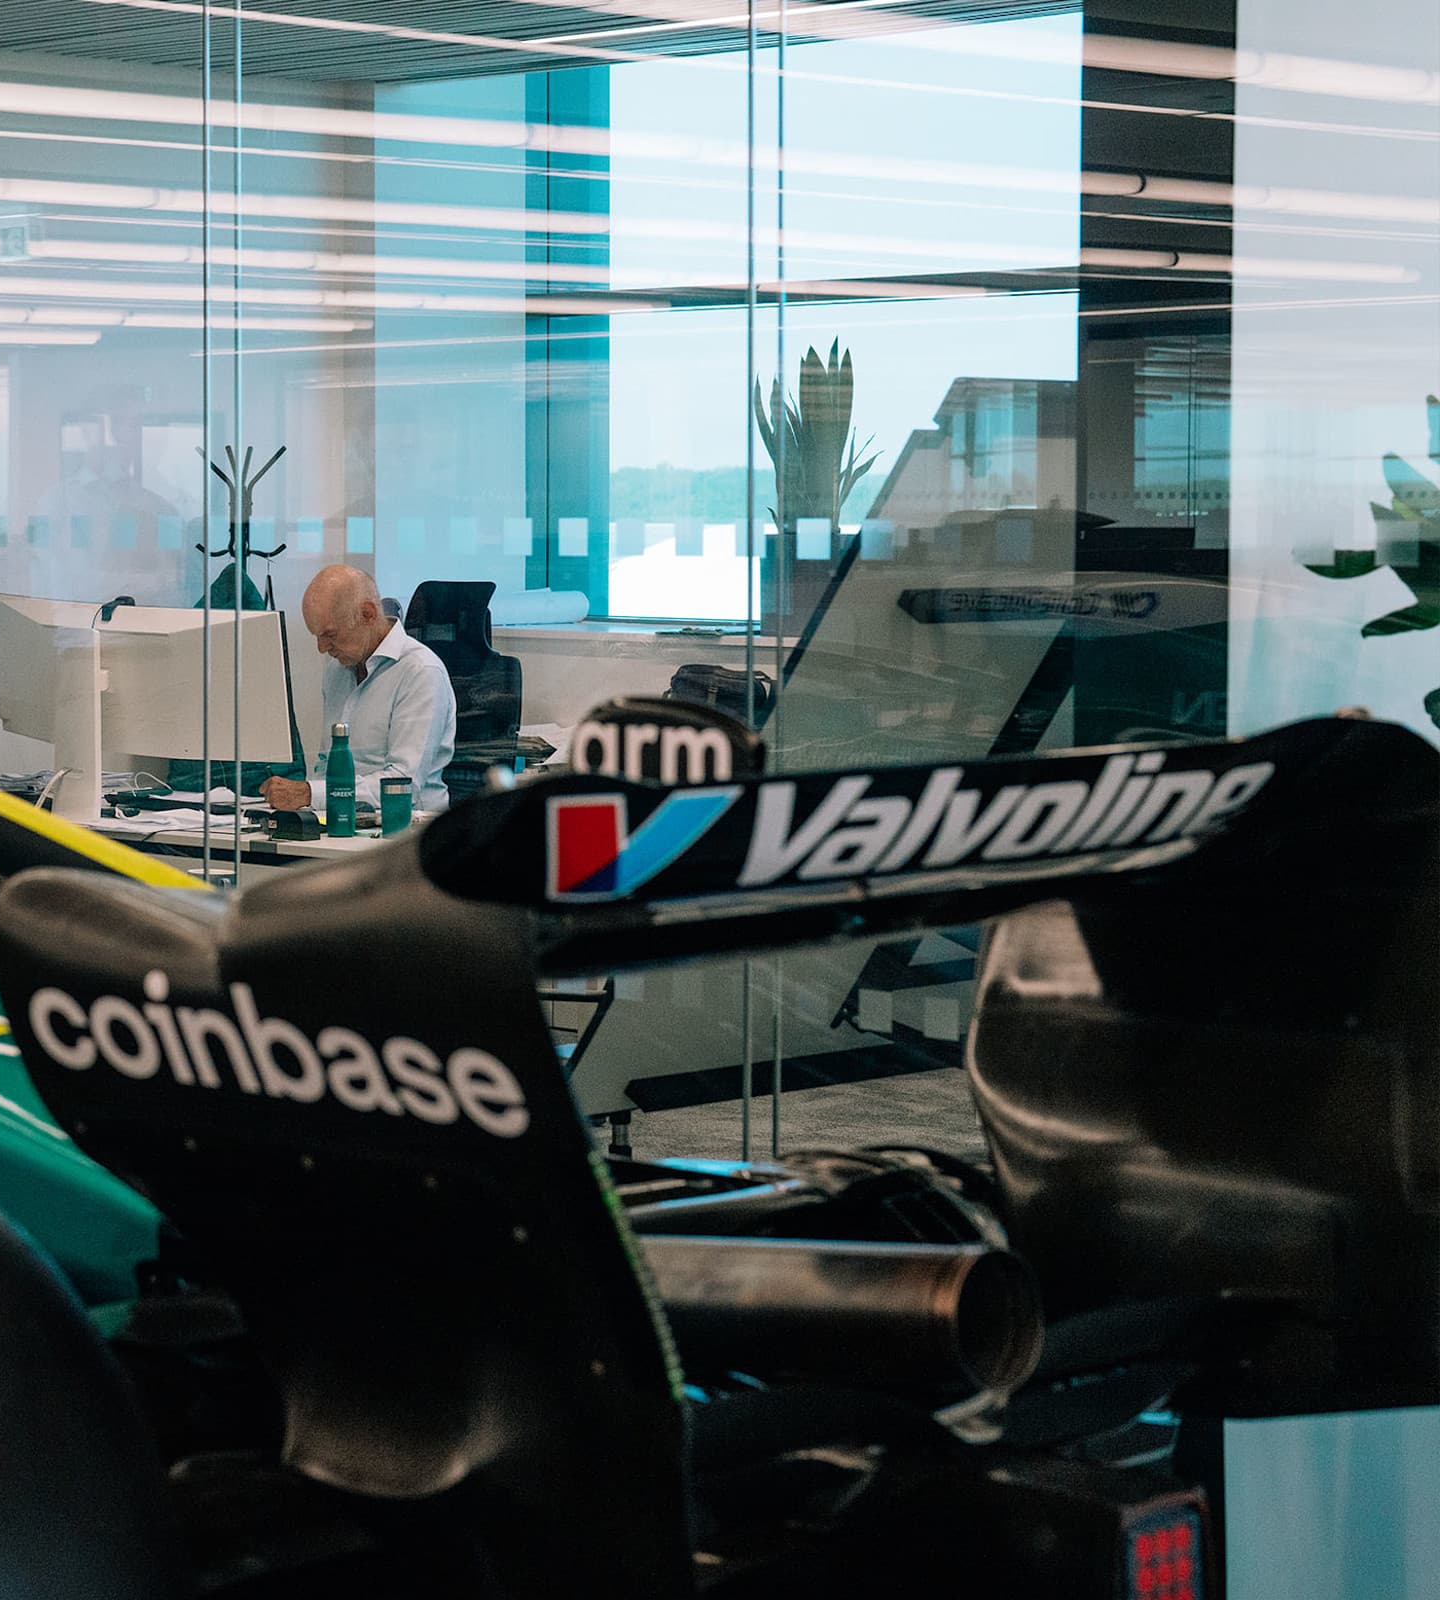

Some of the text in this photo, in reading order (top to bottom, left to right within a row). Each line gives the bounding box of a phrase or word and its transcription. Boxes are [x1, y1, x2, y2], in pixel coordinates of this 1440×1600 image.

[572, 720, 733, 785] arm
[737, 752, 1276, 887] Valvoline
[29, 968, 530, 1139] coinbase
